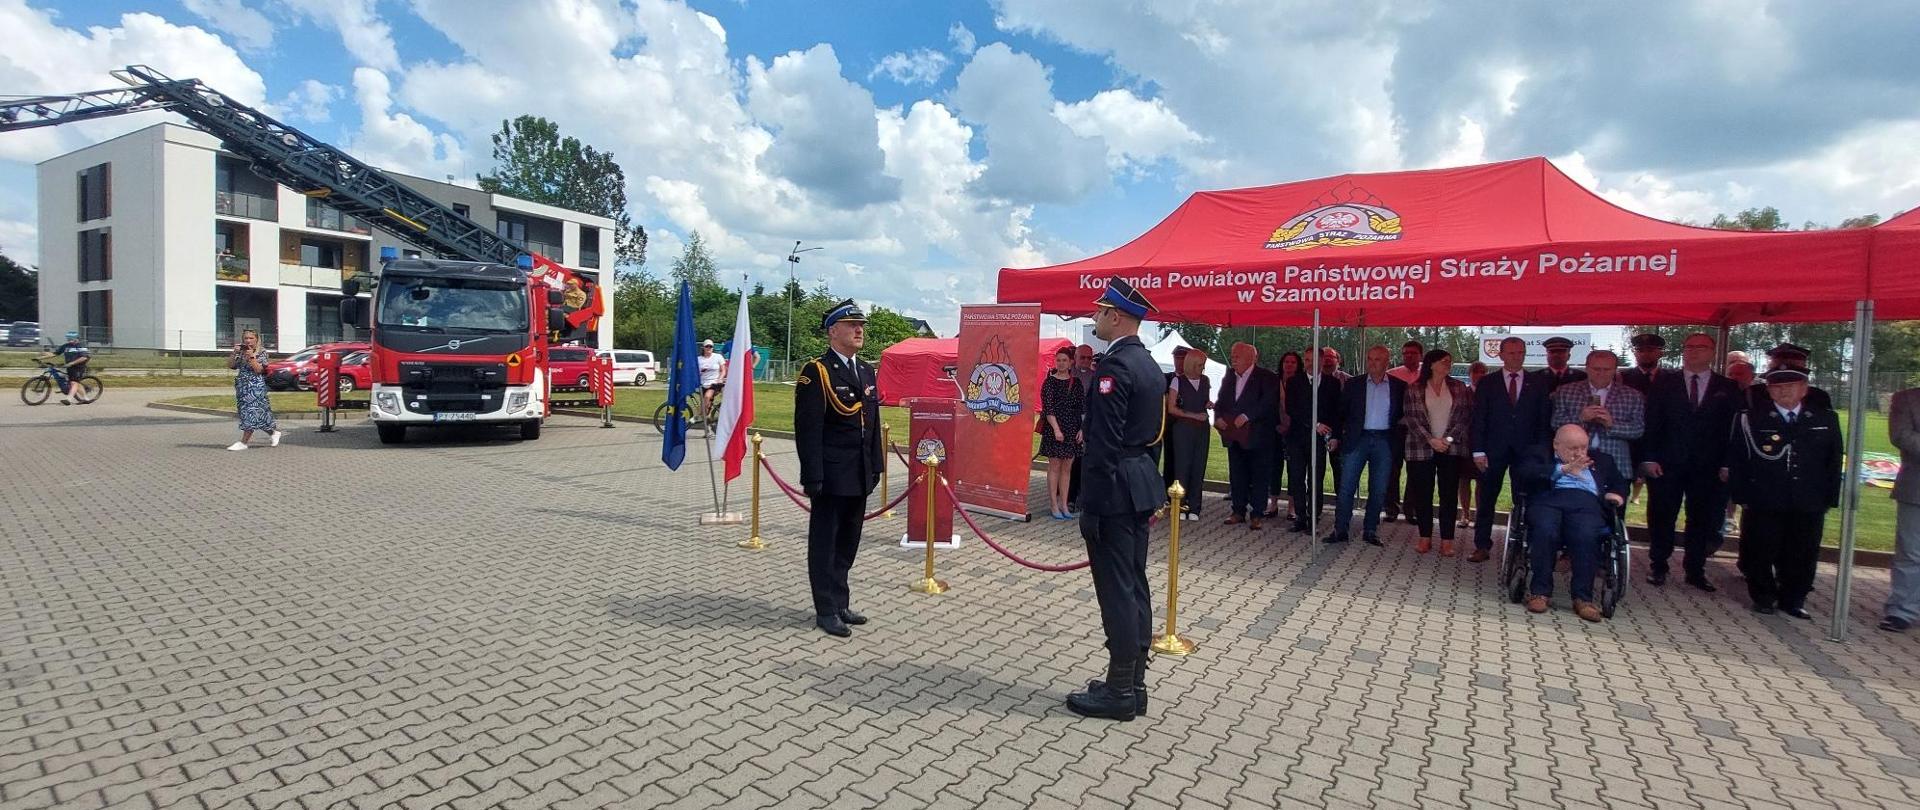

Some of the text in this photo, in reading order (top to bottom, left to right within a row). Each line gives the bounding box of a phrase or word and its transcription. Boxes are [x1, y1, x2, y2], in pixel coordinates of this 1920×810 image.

[1079, 249, 1678, 289] Konda Powiatowa Państwowej Straży Pożarnej
[1237, 281, 1415, 303] w Szamotułach
